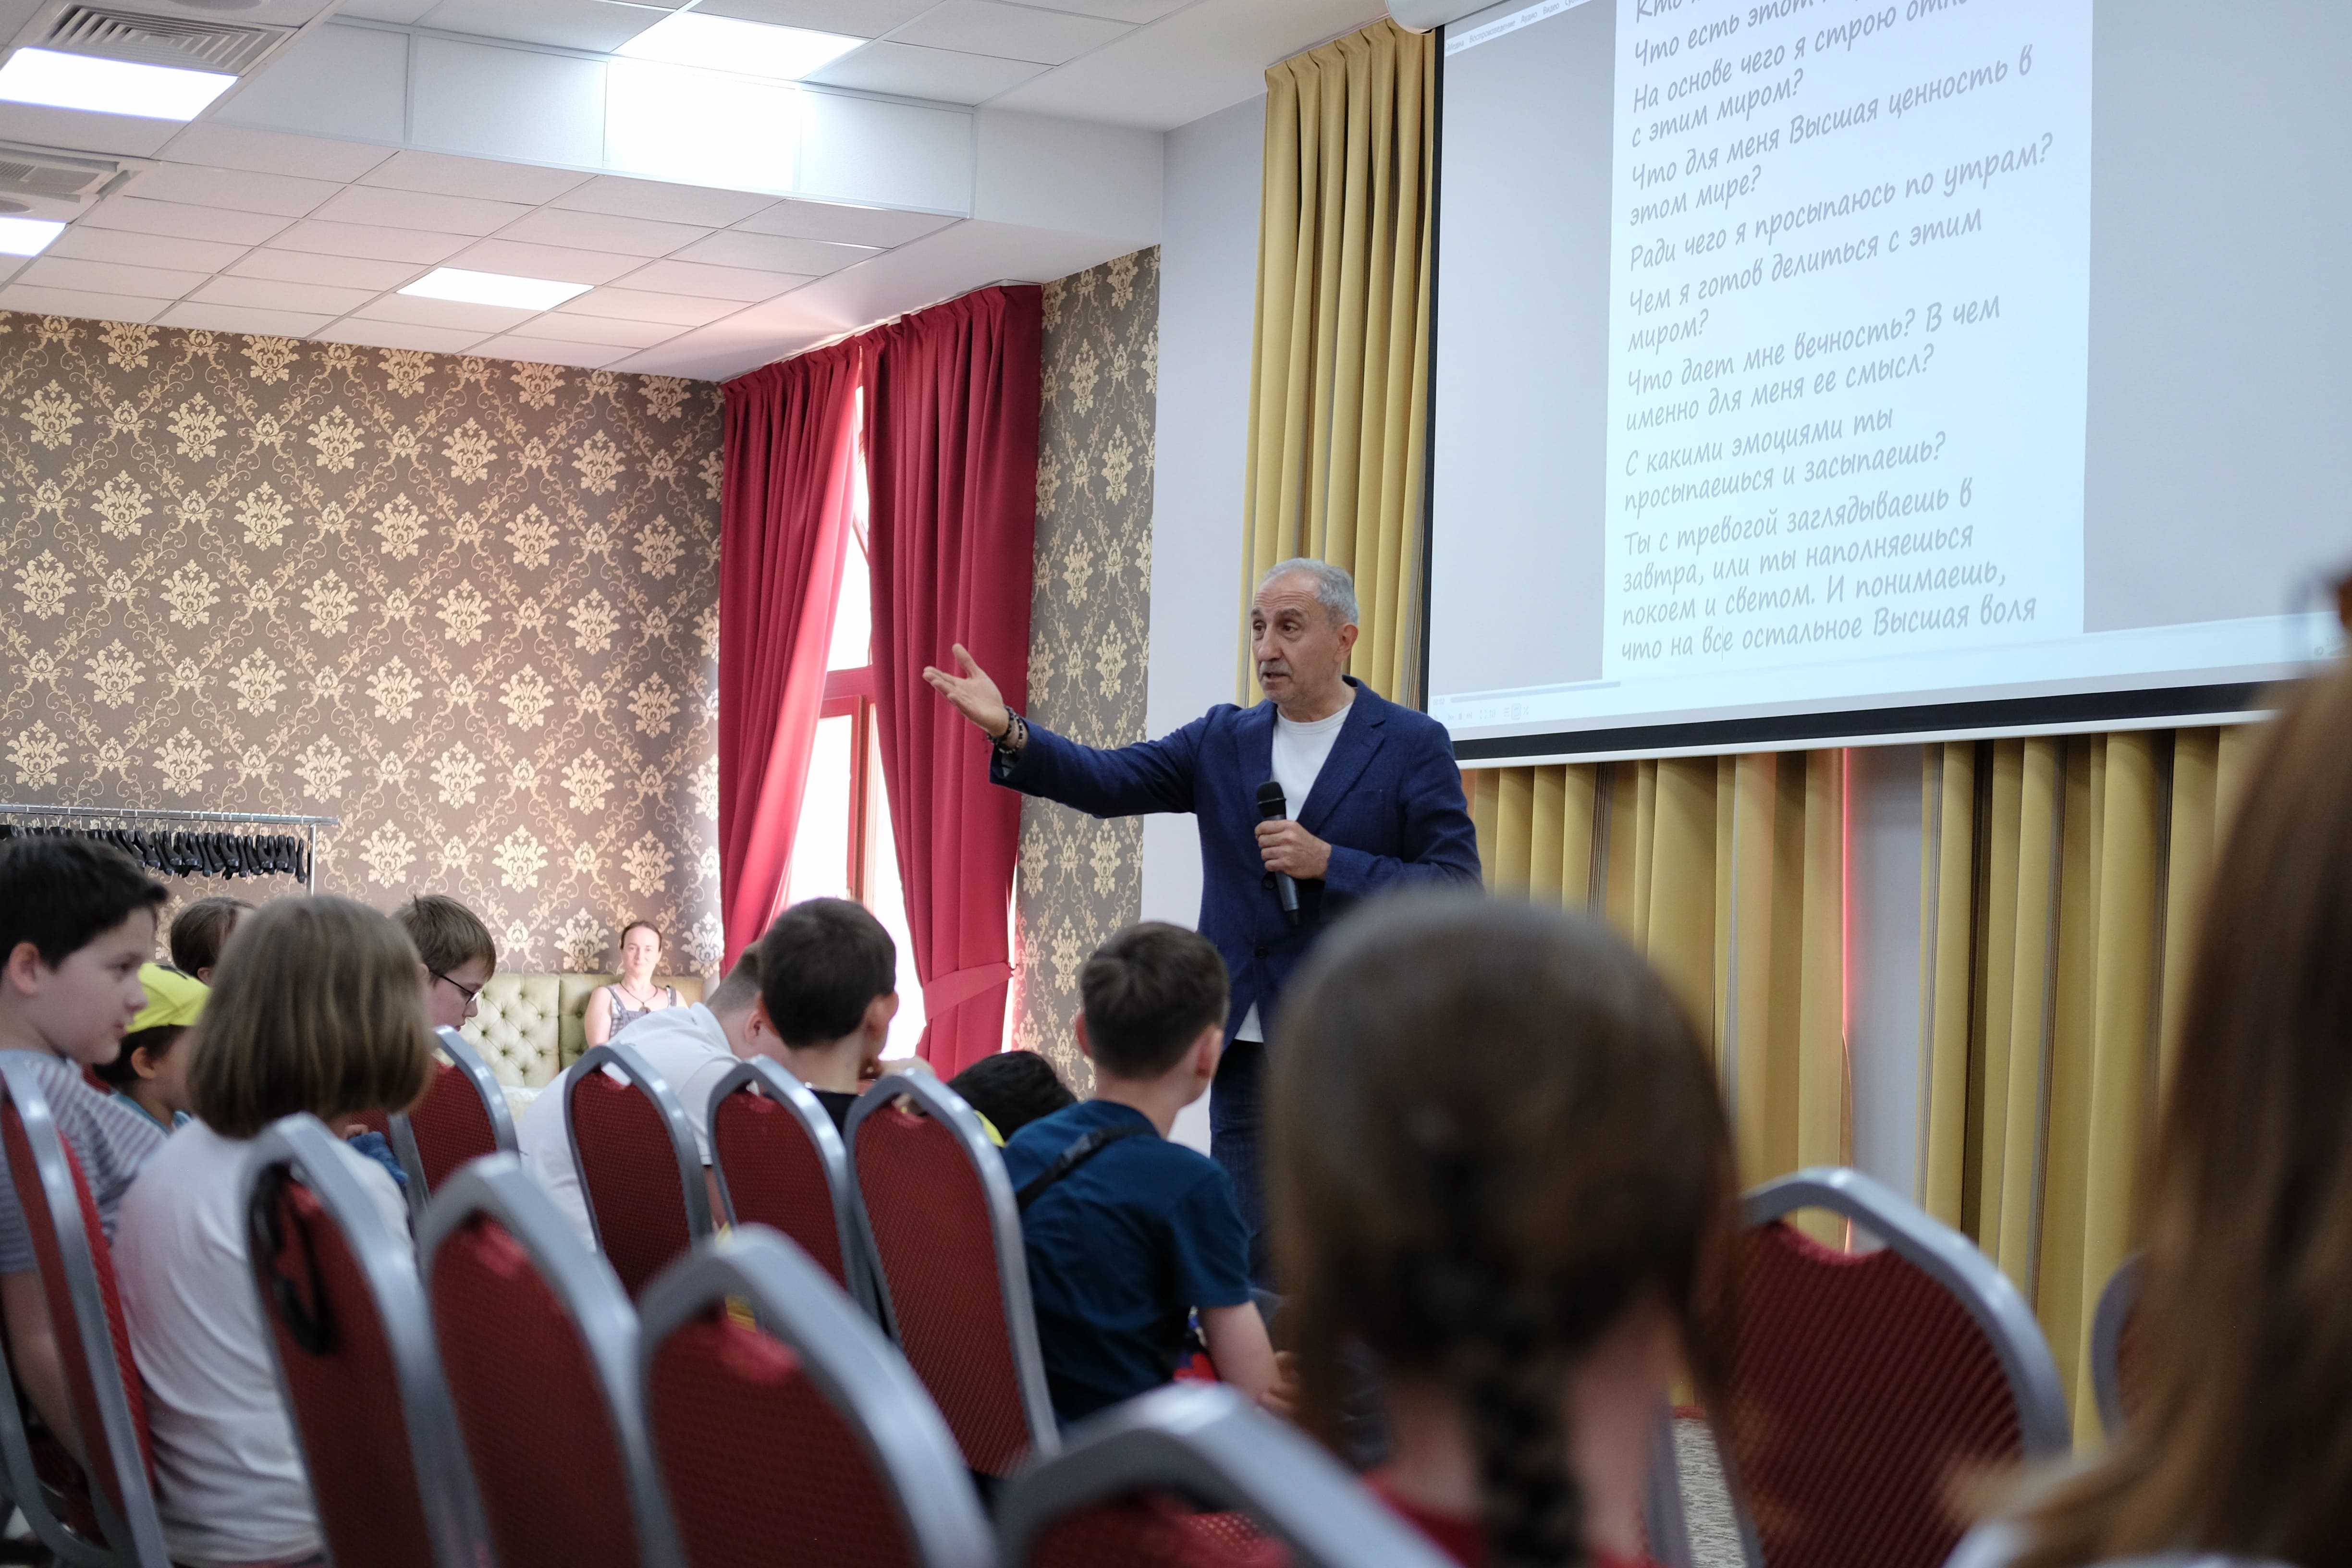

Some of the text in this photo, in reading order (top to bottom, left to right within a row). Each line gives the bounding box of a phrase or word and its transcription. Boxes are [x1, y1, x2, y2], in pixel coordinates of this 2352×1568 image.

[1633, 84, 1659, 113] На
[1667, 58, 1732, 101] основе
[1740, 45, 1785, 74] чего
[1794, 37, 1806, 61] я
[1814, 6, 1897, 52] строю
[1635, 36, 1679, 67] Что
[1688, 14, 1740, 49] есть
[1632, 67, 1803, 147] с этим миром?
[1632, 44, 2033, 190] Что для меня Высшая ценность в
[1630, 164, 1762, 226] этом мире?
[1630, 132, 2053, 271] Ради чего я просыпаюсь по утрам?
[1630, 208, 1982, 316] Чем я готов делиться с этим
[1628, 308, 1709, 355] миром?
[1629, 295, 1999, 396] Что дает мне вечность? В чем
[1627, 343, 1934, 431] именно для меня ее смысл?
[1625, 430, 1946, 520] просыпаешься и засыпаешь?
[1626, 408, 1893, 477] С какими эмоциями ты
[1624, 477, 1972, 556] Ты с тревогой заглядываешь в
[1623, 525, 1973, 595] завтра, или ты наполняешься
[1623, 561, 2005, 626] покоем и светом. И понимаешь,
[1622, 593, 2036, 661] что на все остальное Высшая воля
